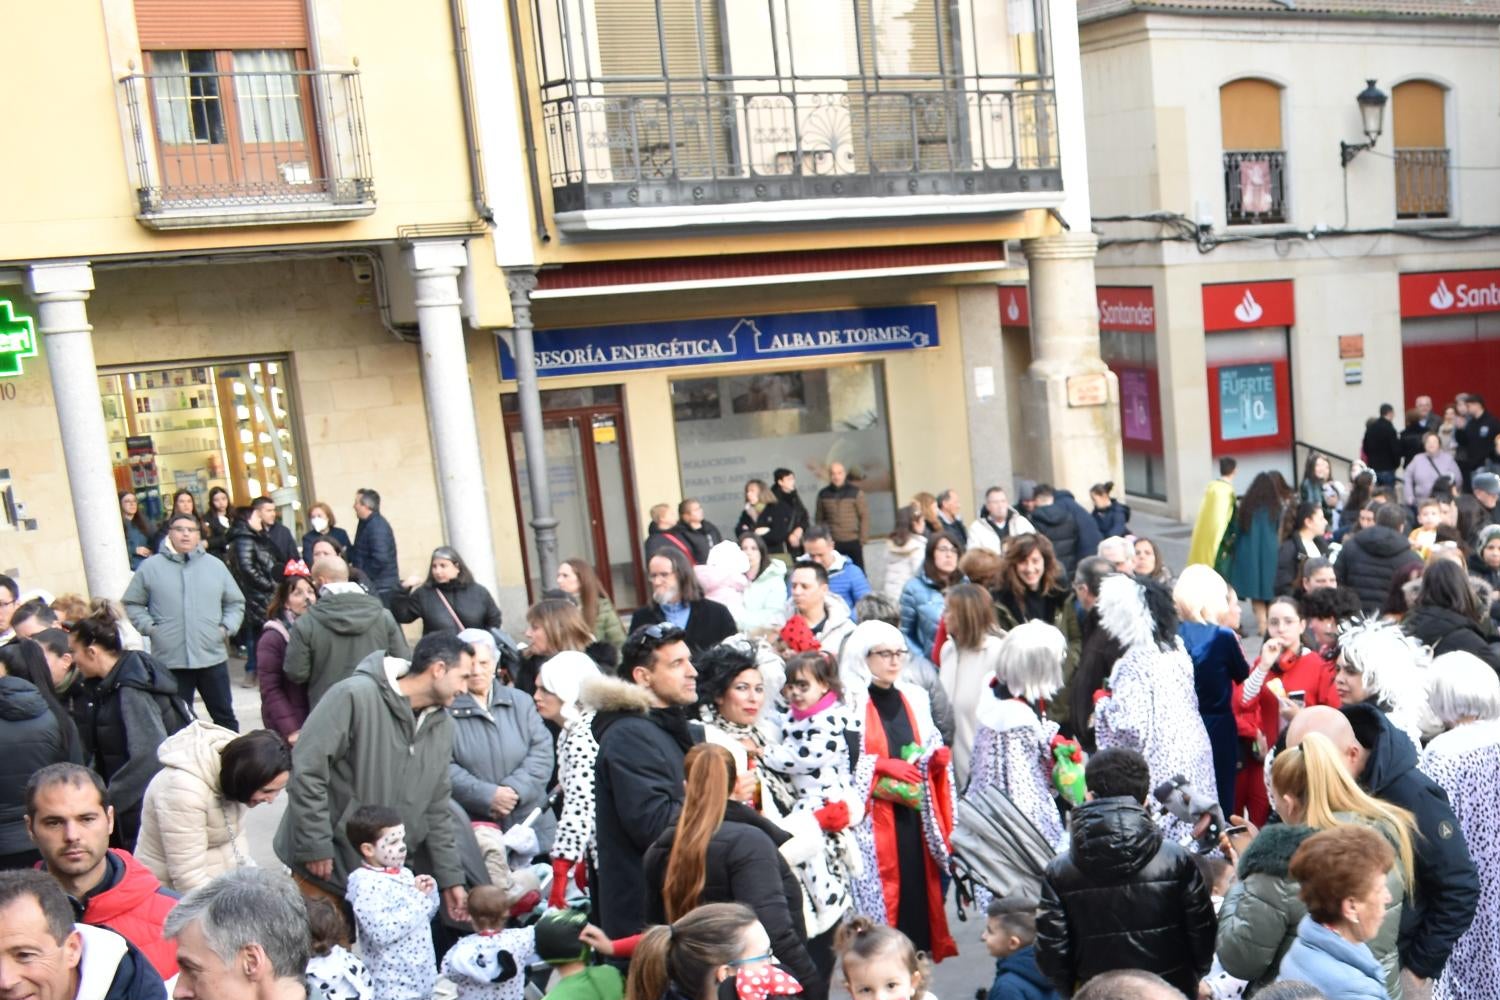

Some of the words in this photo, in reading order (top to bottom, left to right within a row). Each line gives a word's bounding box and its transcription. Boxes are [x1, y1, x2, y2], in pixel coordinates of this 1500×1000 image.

[1101, 301, 1155, 326] Santander
[534, 343, 606, 367] SESORÍA
[610, 338, 724, 362] ENERGÉTICA
[770, 332, 816, 349] ALBA
[818, 329, 841, 345] DE
[843, 325, 911, 344] TORMES
[1221, 376, 1273, 396] FUERTE
